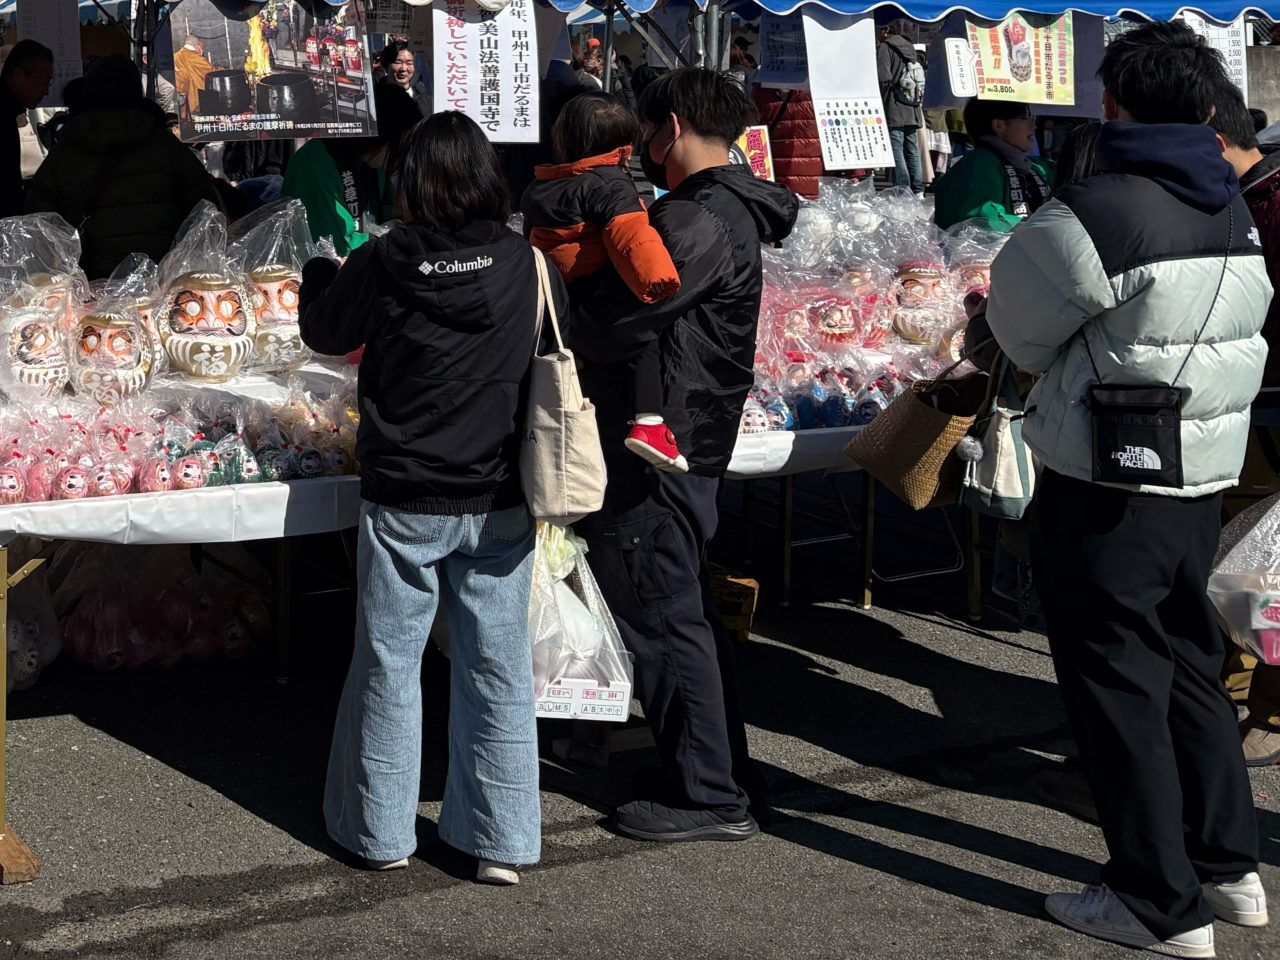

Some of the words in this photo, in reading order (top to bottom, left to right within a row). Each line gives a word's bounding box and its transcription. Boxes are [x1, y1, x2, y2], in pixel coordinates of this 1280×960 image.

[434, 255, 493, 274] Columbia
[1124, 445, 1144, 454] THE
[1111, 451, 1144, 461] NORTH
[1120, 460, 1144, 469] FACE
